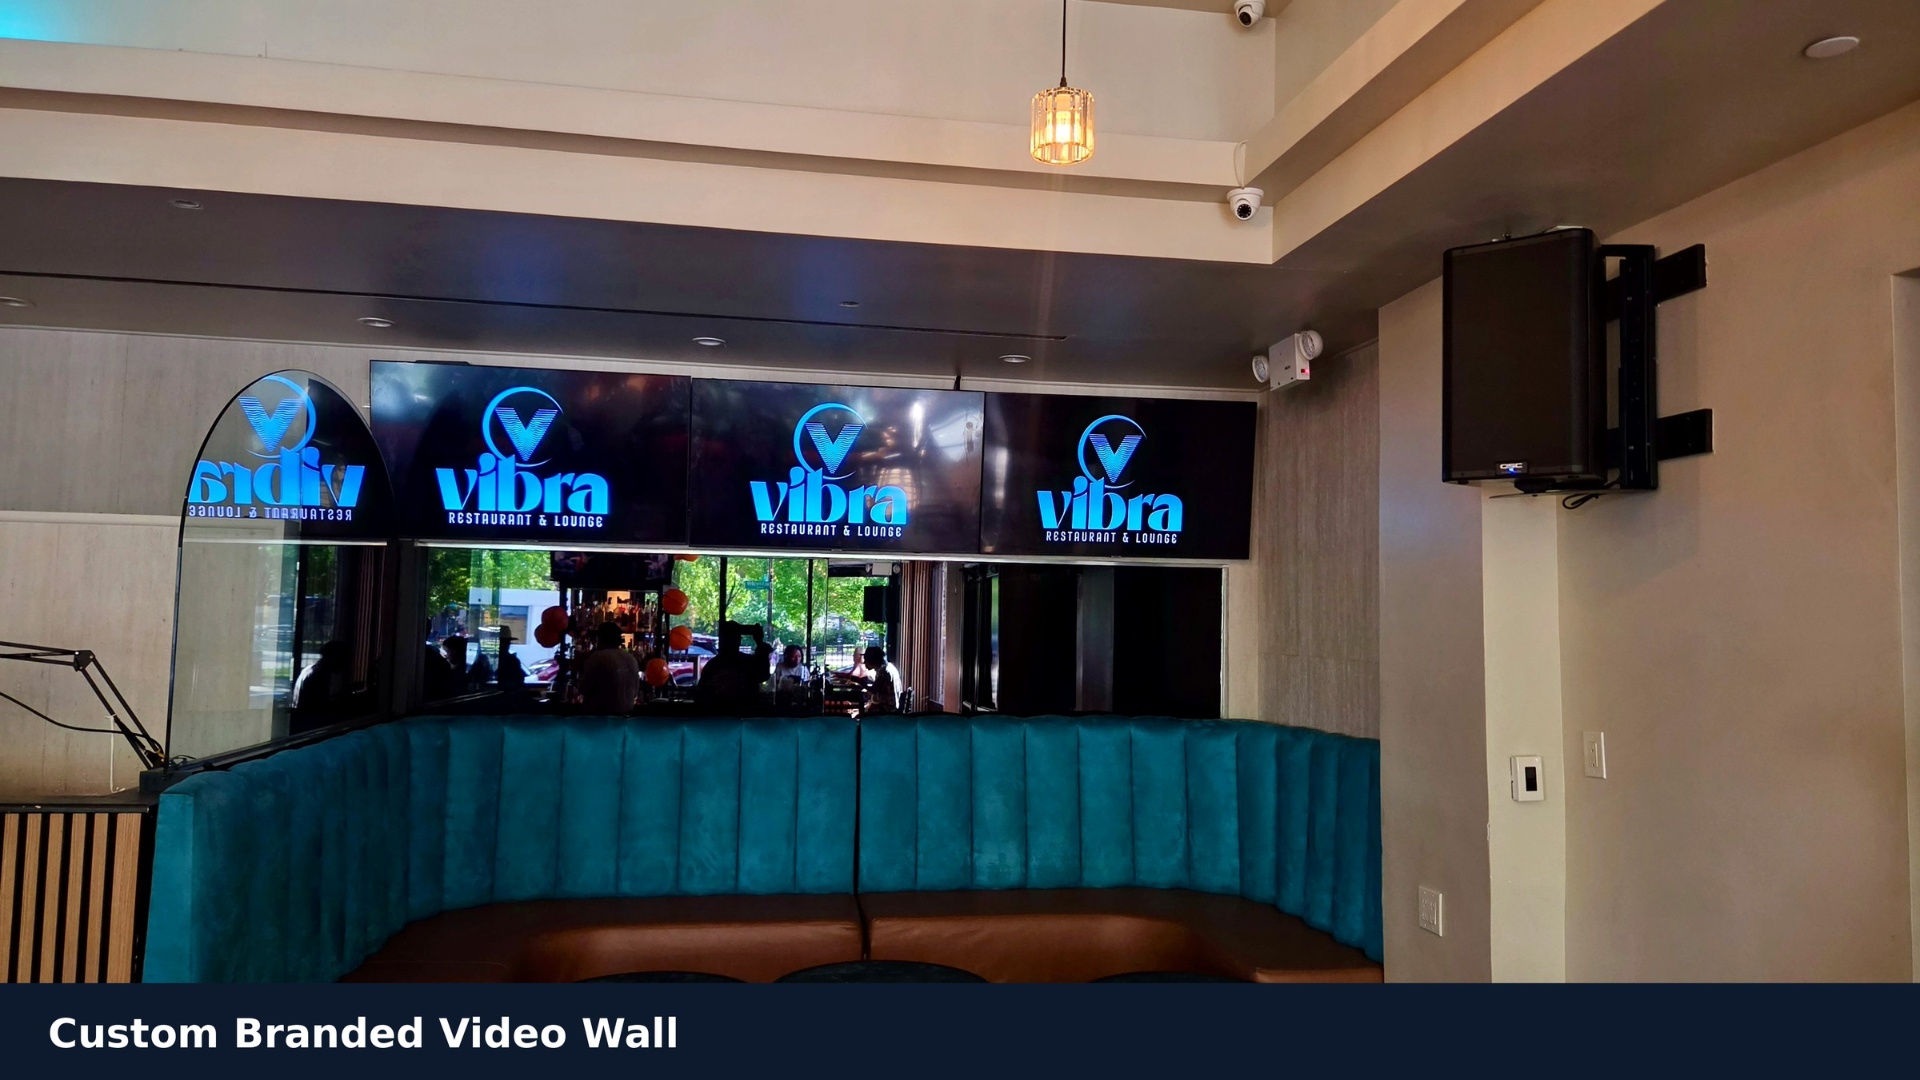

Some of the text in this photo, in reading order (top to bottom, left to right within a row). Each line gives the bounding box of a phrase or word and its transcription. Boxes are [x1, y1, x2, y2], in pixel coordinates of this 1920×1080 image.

[435, 452, 609, 514] vibra
[750, 466, 907, 525] vibra
[449, 512, 603, 527] RESTAURANT & LOUNGE
[1037, 475, 1182, 531] vibra
[761, 523, 902, 537] RESTAURANT & LOUNGE
[1046, 530, 1178, 544] RESTAURANT & LOUNGE
